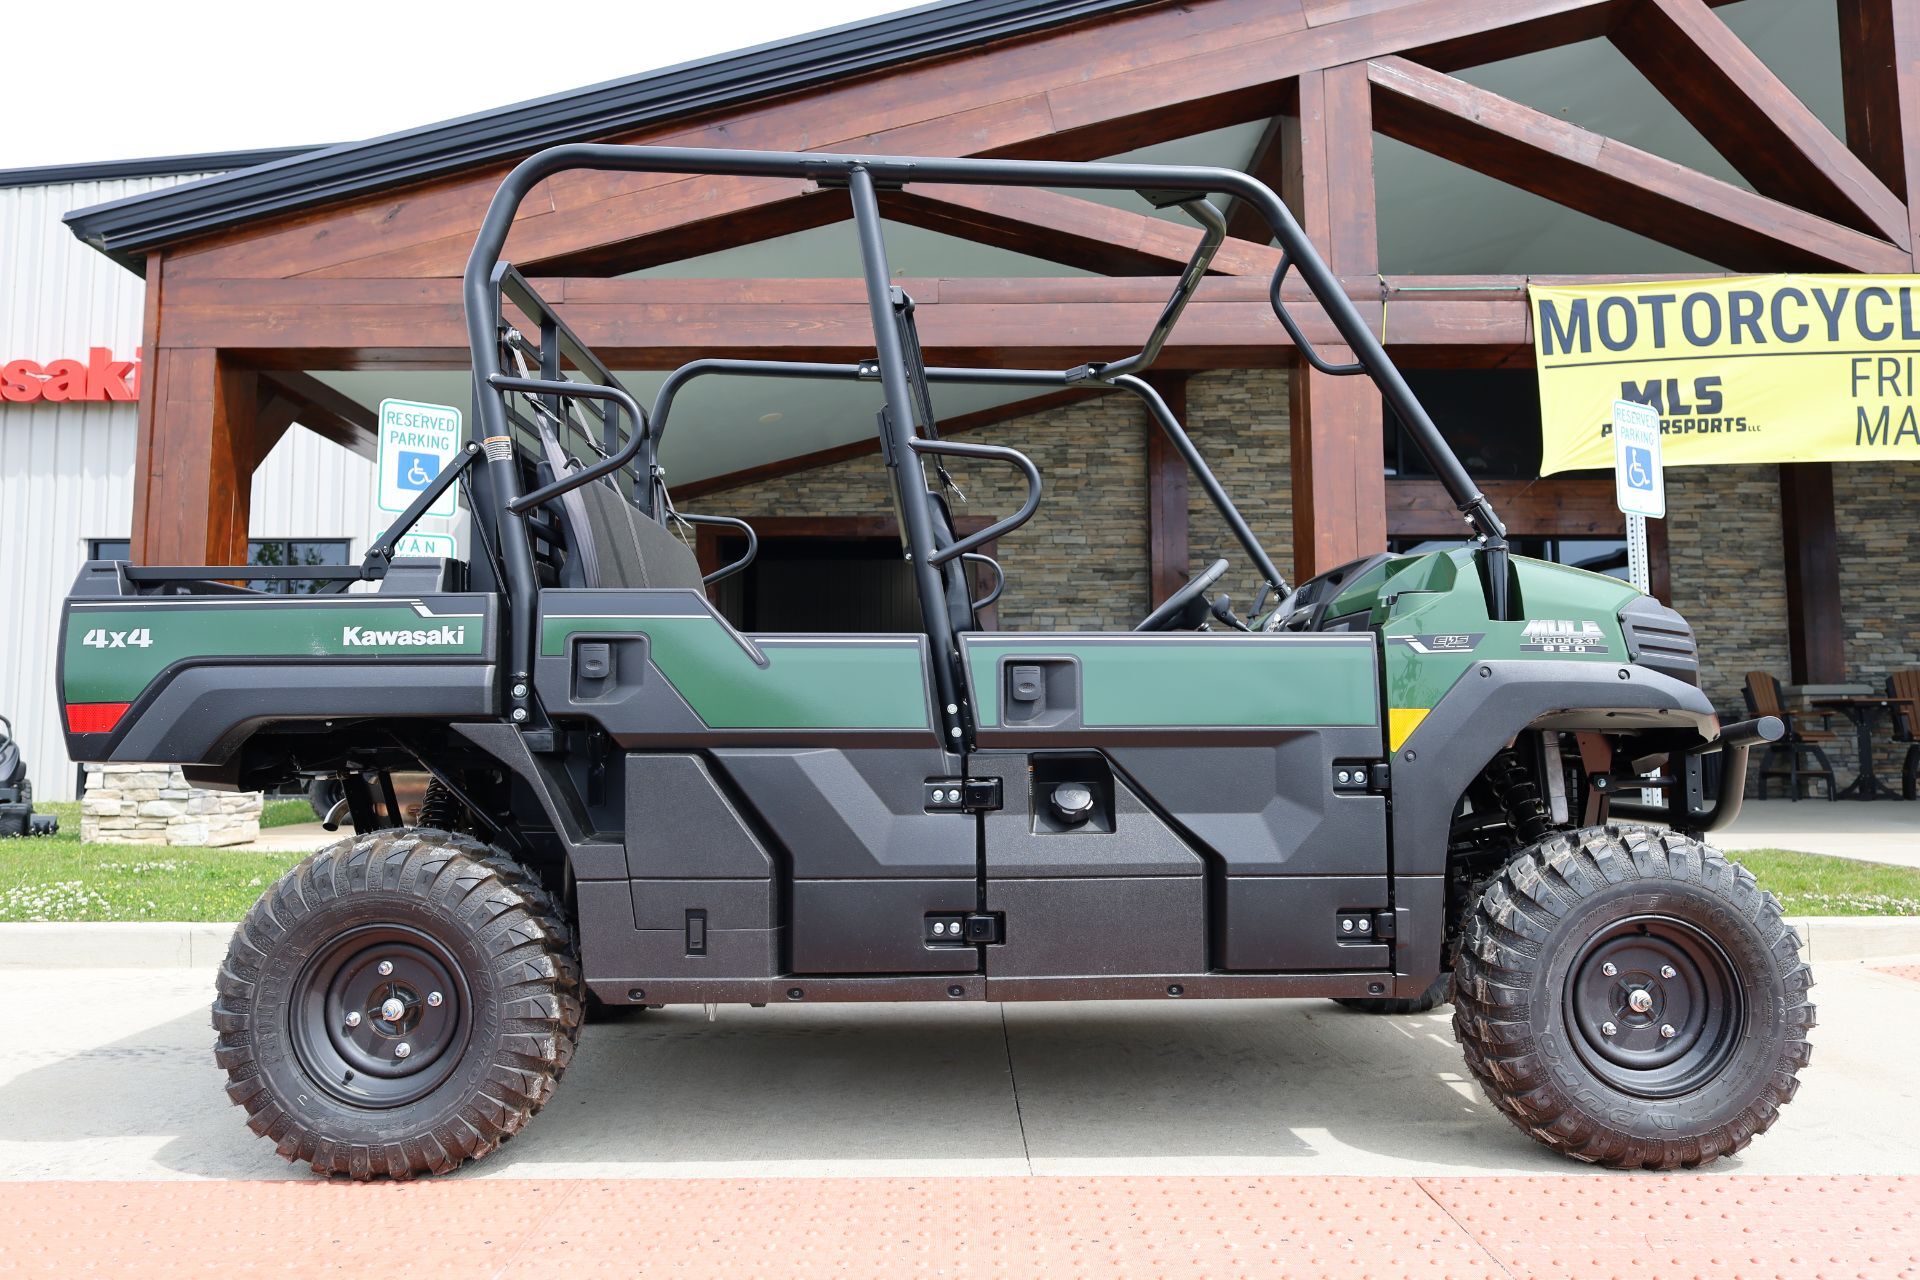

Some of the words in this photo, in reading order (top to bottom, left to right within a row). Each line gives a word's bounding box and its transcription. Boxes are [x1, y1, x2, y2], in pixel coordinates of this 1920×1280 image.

[1538, 287, 1920, 356] MOTORCYCL
[1852, 357, 1913, 398] FRI
[1620, 376, 1723, 416] MLS
[386, 411, 455, 432] RESERVED
[1601, 417, 1747, 438] PRSPORTS
[1616, 407, 1657, 429] RESERVED
[1856, 405, 1920, 446] MA
[389, 431, 450, 450] PARKING
[1620, 426, 1655, 445] PARKING
[397, 539, 435, 554] VAN
[82, 628, 154, 648] 4x4
[342, 625, 465, 646] Kawasaki
[1520, 619, 1606, 638] MULE
